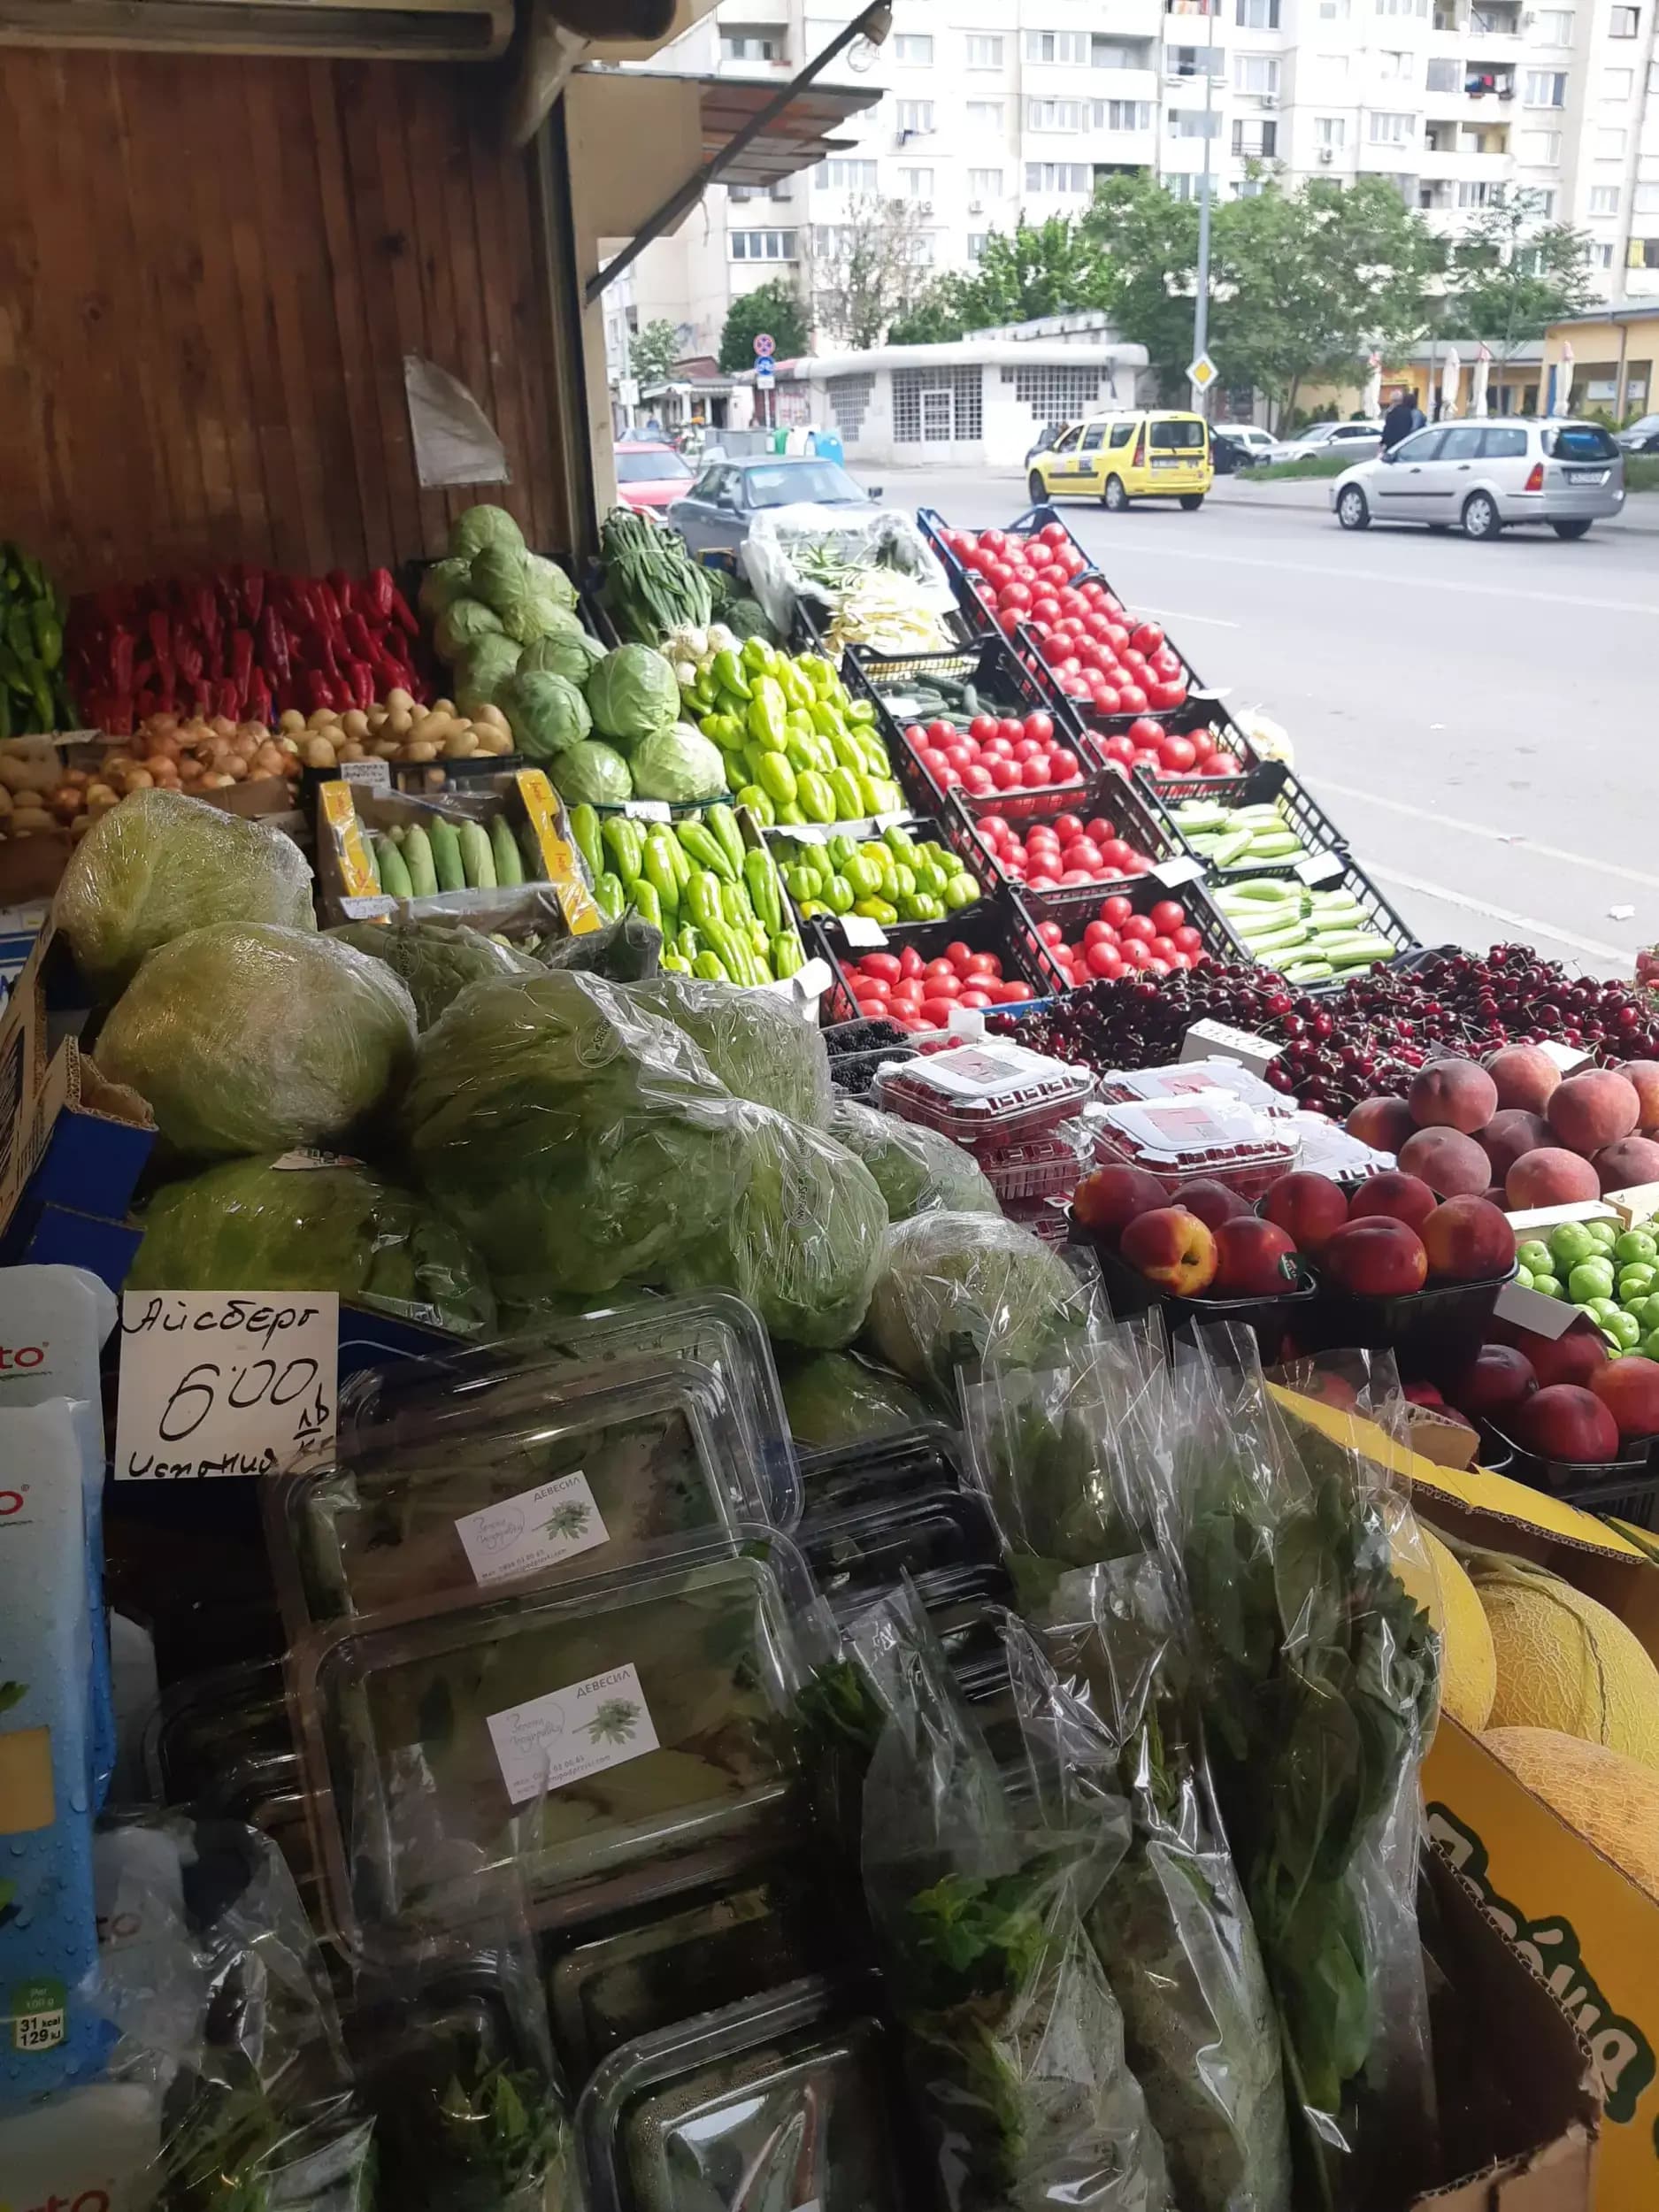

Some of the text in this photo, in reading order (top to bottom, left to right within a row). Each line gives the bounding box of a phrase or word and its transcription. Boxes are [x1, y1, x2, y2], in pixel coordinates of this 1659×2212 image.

[534, 1477, 580, 1502] ДЕВЕСИЛ
[576, 1670, 631, 1699] ДЕВЕСИЛ
[20, 2016, 61, 2032] 31 kcal
[20, 2029, 50, 2047] 129
